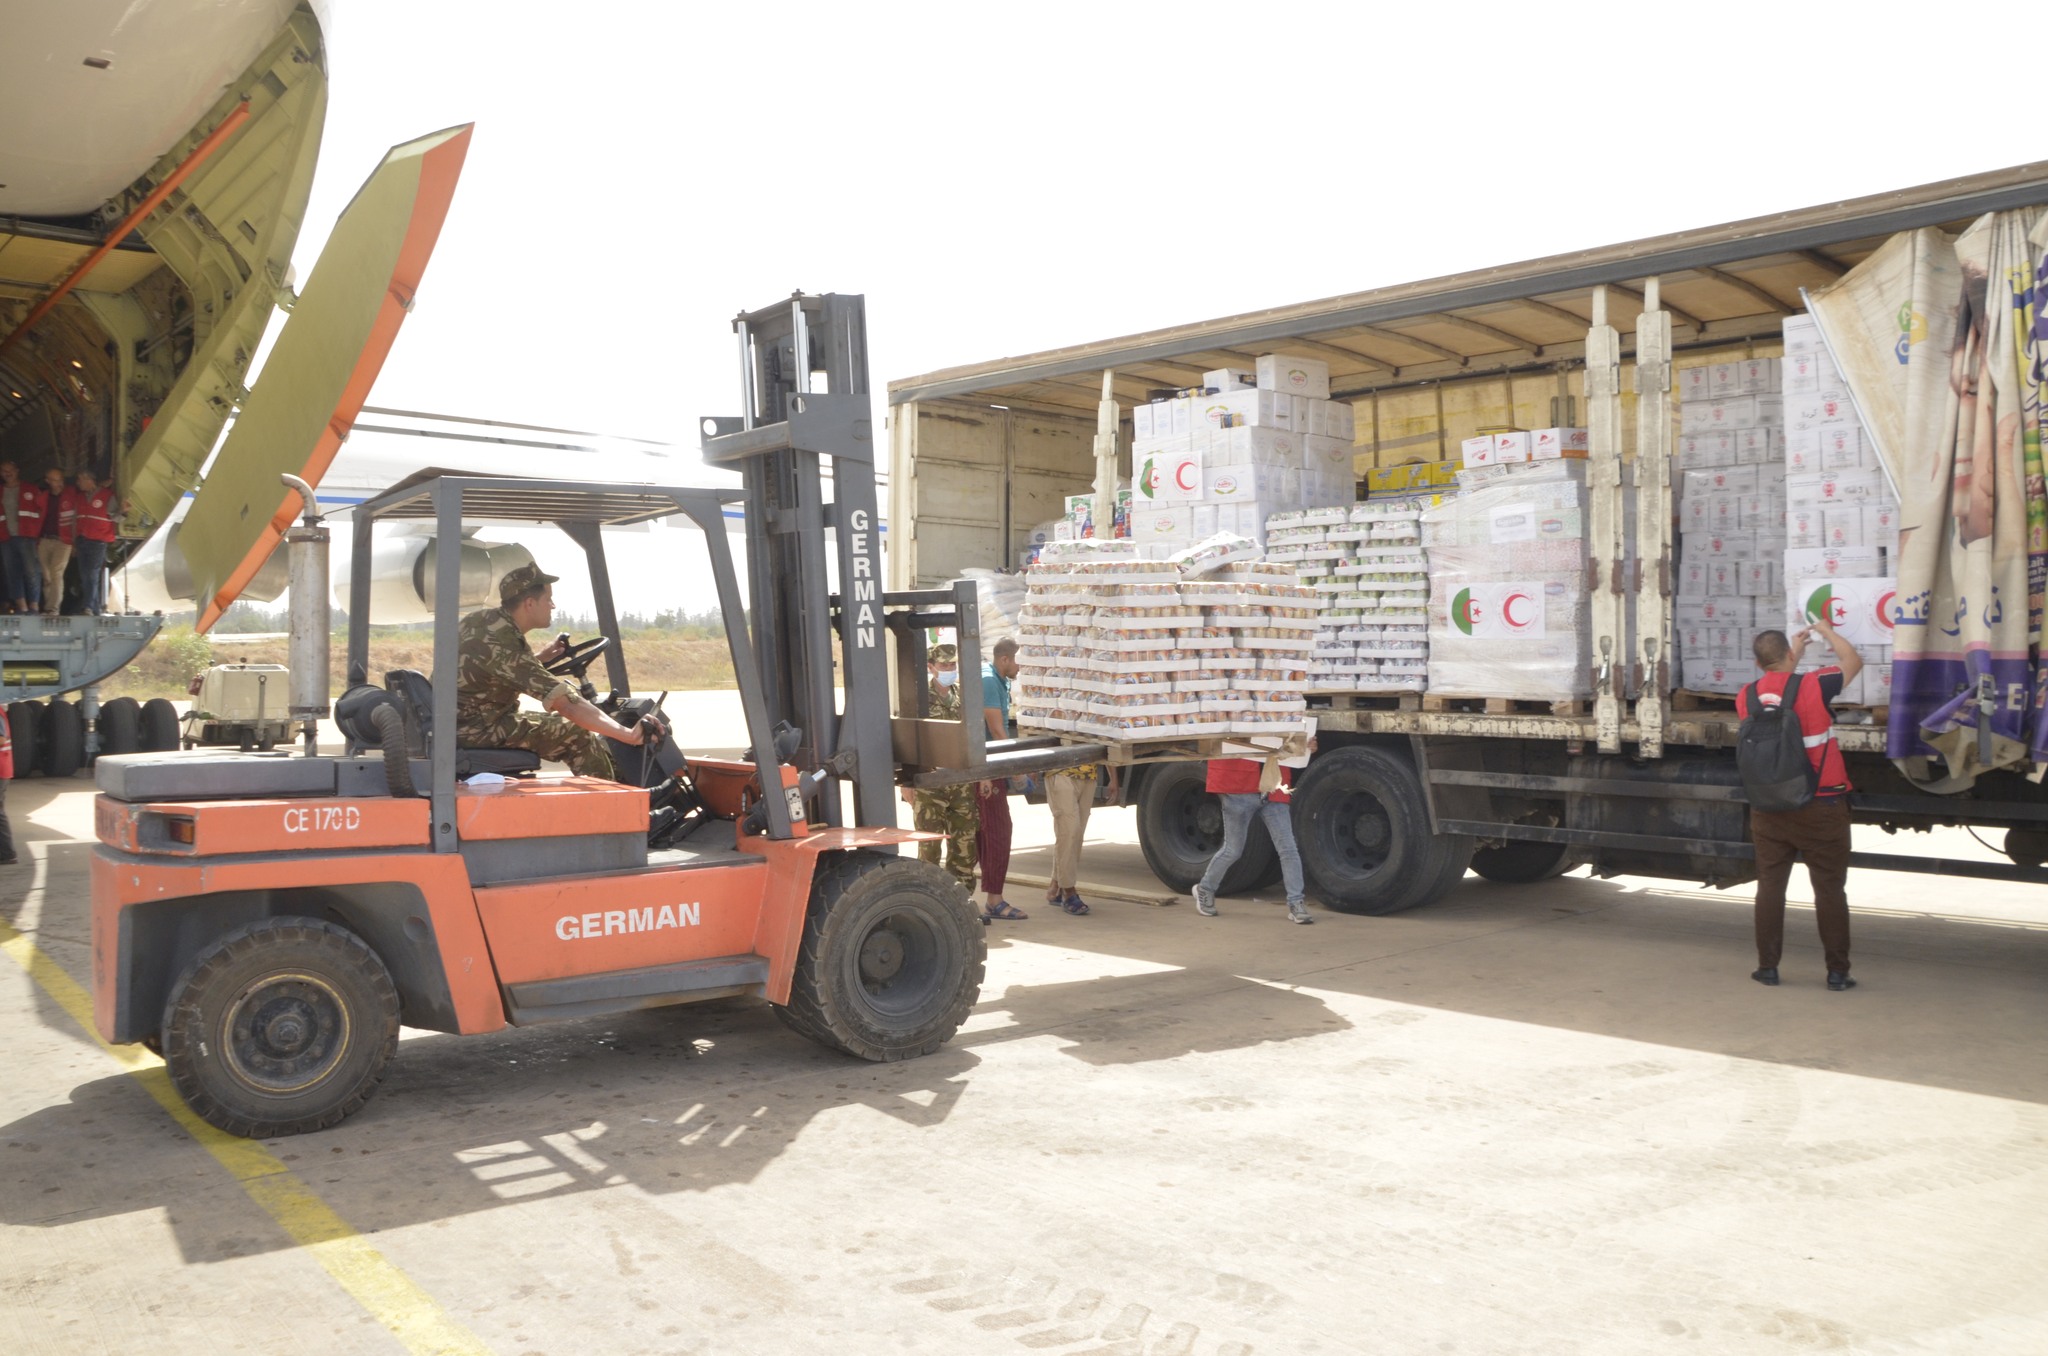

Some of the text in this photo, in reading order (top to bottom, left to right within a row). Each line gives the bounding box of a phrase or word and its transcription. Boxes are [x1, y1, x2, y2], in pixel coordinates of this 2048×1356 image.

[850, 509, 876, 649] GERMAN
[284, 808, 309, 833] CE
[555, 902, 700, 940] GERMAN
